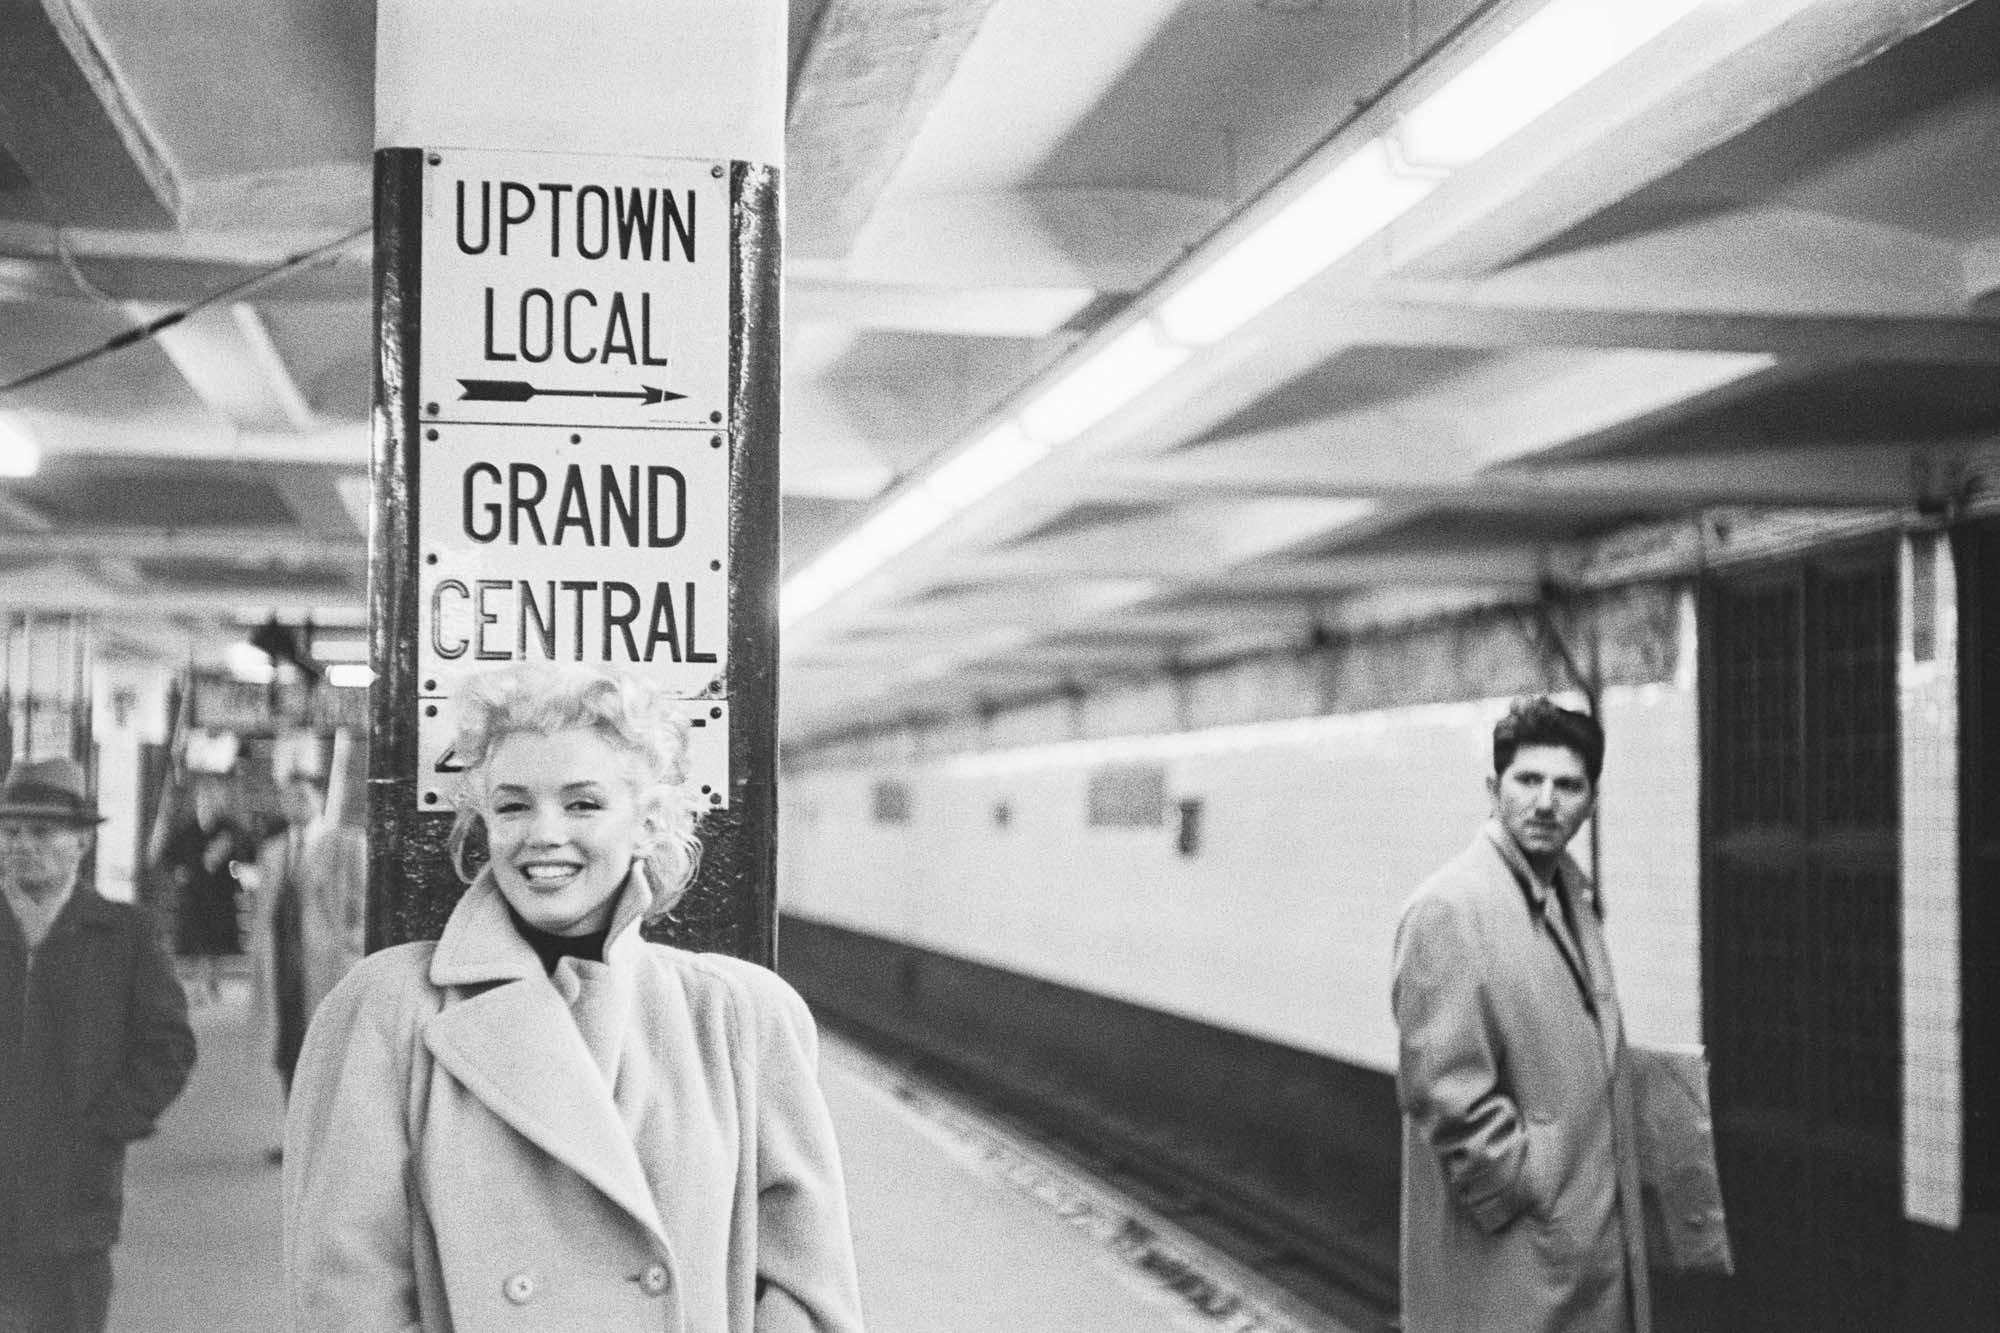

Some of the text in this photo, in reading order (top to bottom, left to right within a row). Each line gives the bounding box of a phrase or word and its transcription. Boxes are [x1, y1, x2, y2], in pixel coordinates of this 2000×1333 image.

[456, 180, 696, 263] UPTOWN
[484, 287, 668, 367] LOCAL
[462, 461, 687, 548] GRAND
[431, 578, 718, 664] CENTRAL
